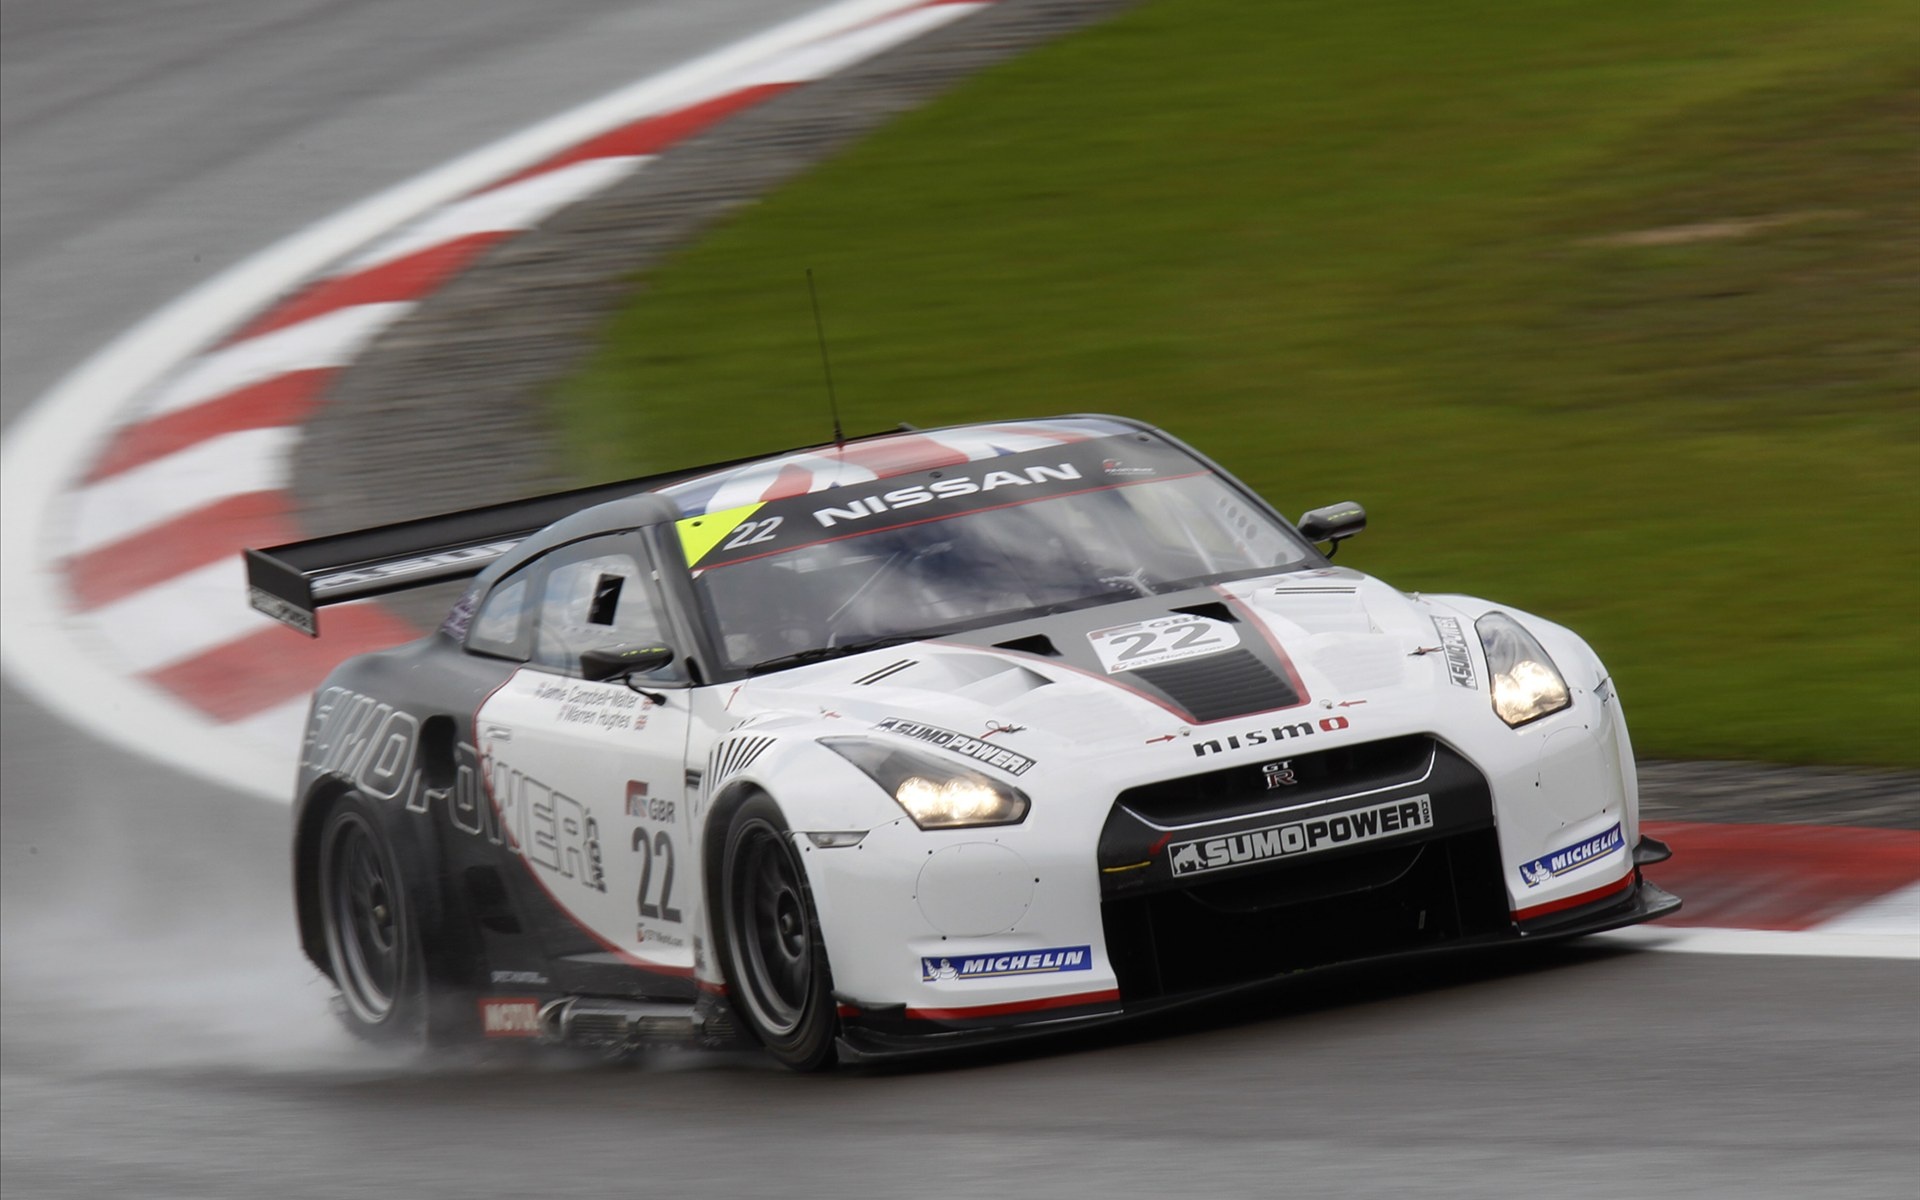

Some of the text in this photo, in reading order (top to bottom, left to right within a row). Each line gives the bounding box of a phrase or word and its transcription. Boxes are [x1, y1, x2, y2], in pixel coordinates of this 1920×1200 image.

[812, 463, 1083, 528] NISSAN
[722, 516, 785, 551] 22
[1110, 623, 1221, 661] 22
[891, 722, 1027, 773] SUMOPOWER
[1193, 716, 1349, 757] nismo
[650, 798, 676, 823] GBR
[1205, 801, 1421, 867] SUMOPOWER
[1552, 827, 1620, 871] MICHELIN
[632, 827, 682, 923] 22
[962, 951, 1084, 974] MICHELIN
